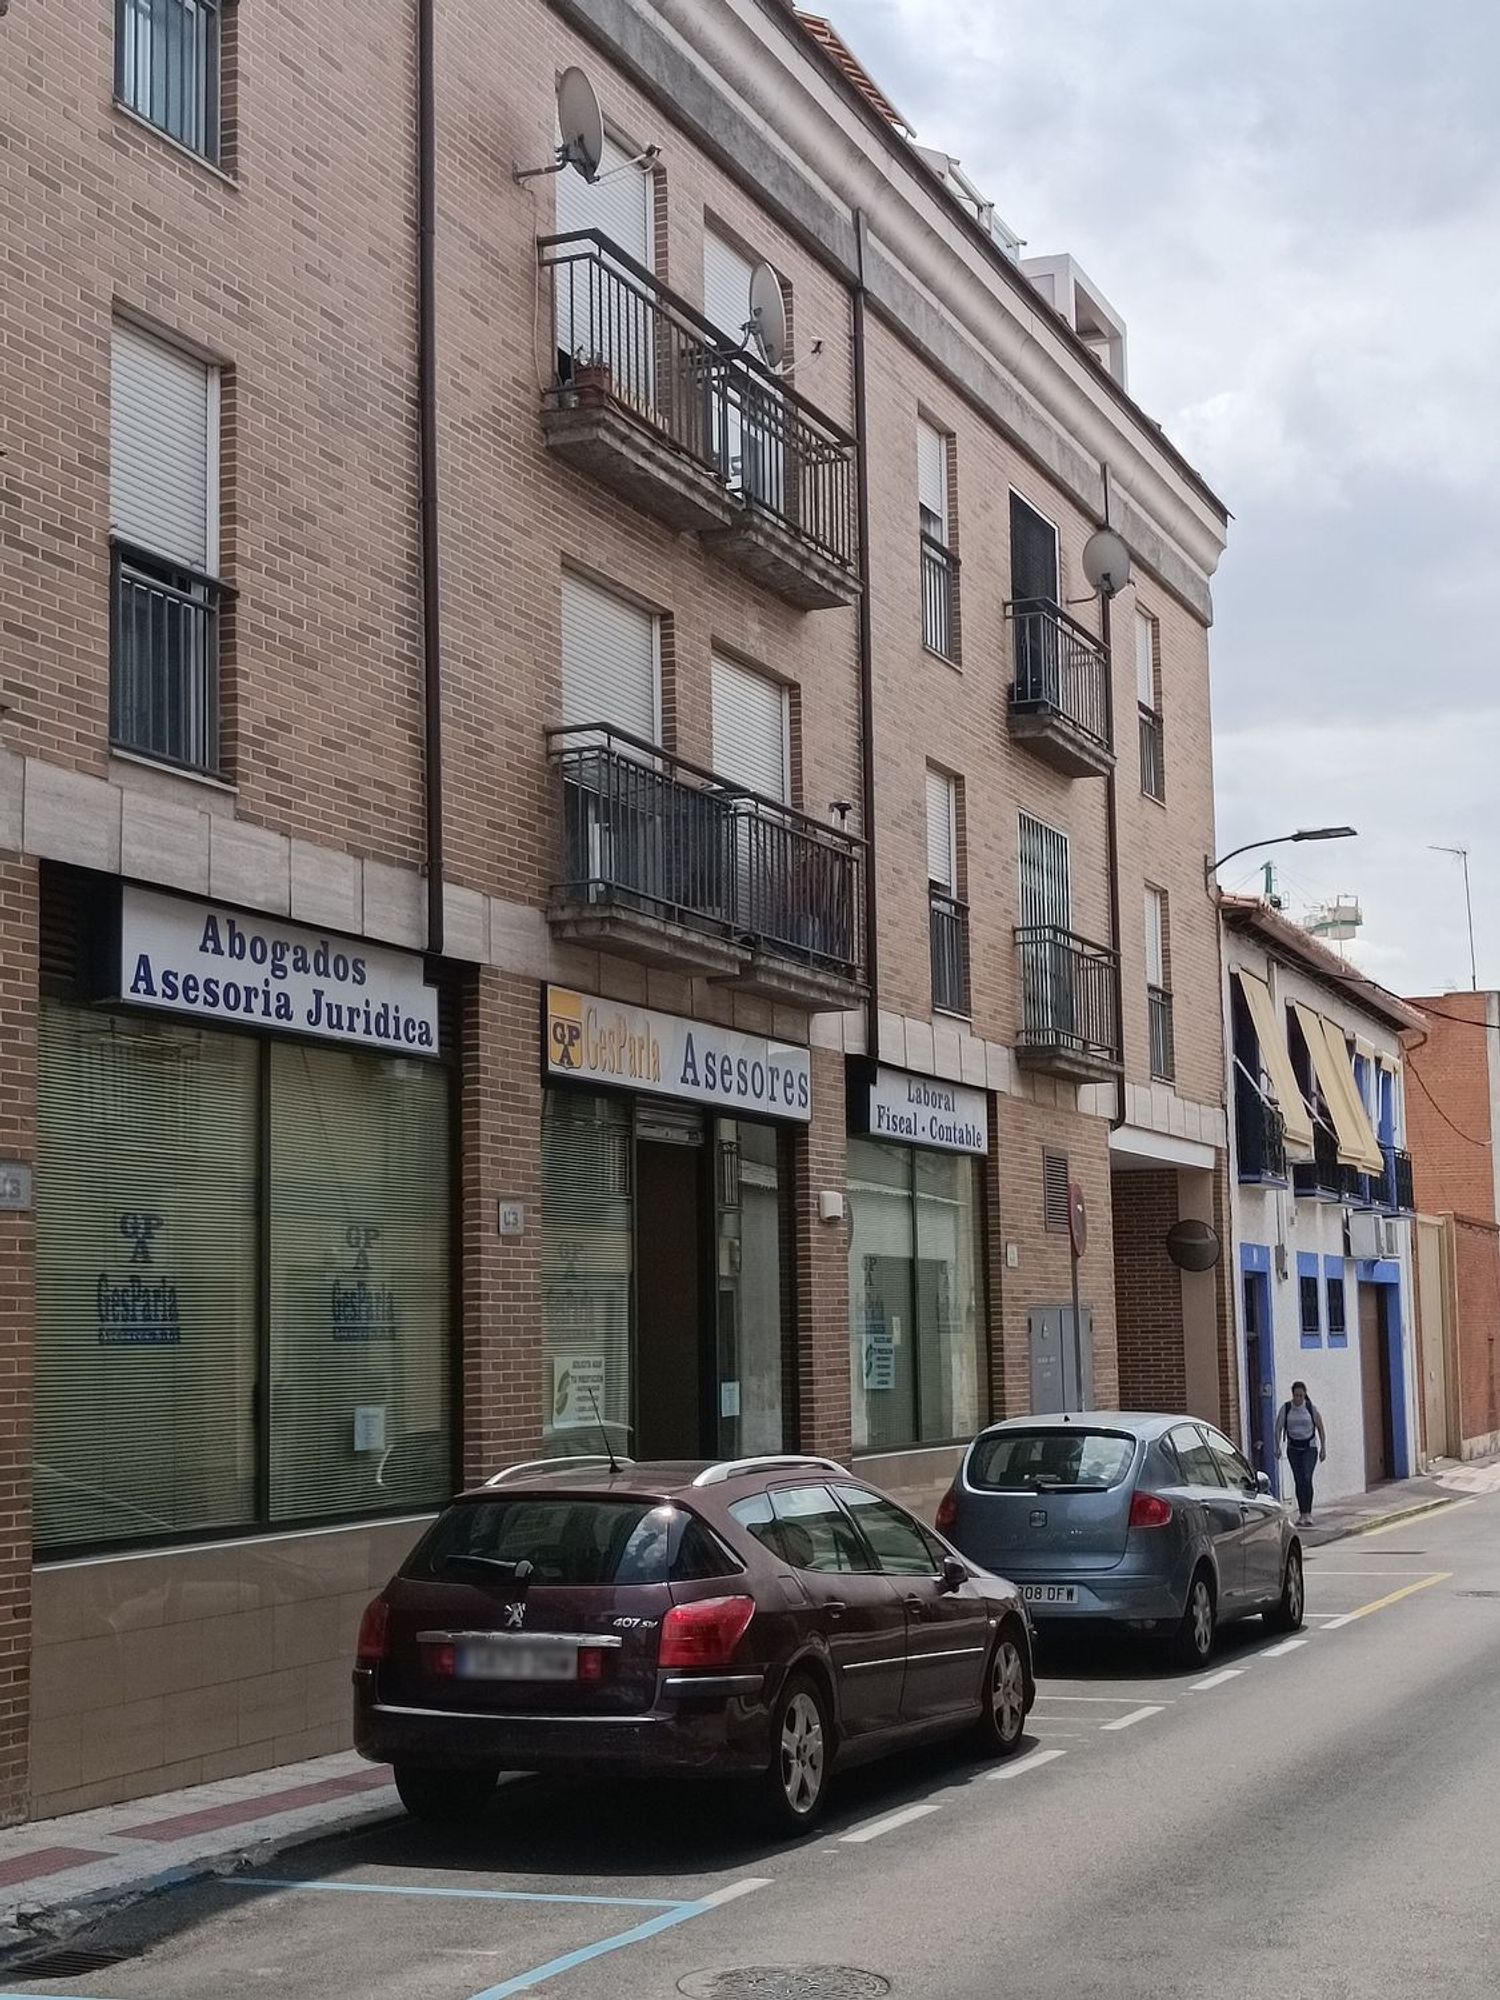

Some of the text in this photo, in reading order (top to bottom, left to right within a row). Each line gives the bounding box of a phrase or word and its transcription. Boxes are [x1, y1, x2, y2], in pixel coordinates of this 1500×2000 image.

[199, 914, 367, 986] Abogados
[130, 954, 434, 1047] Asesoria Juridica
[680, 1032, 808, 1108] Asesores
[907, 1079, 955, 1112] Laboral
[877, 1104, 983, 1148] Fiscal Contable
[1047, 1586, 1075, 1601] DFW
[612, 1617, 641, 1628] 407
